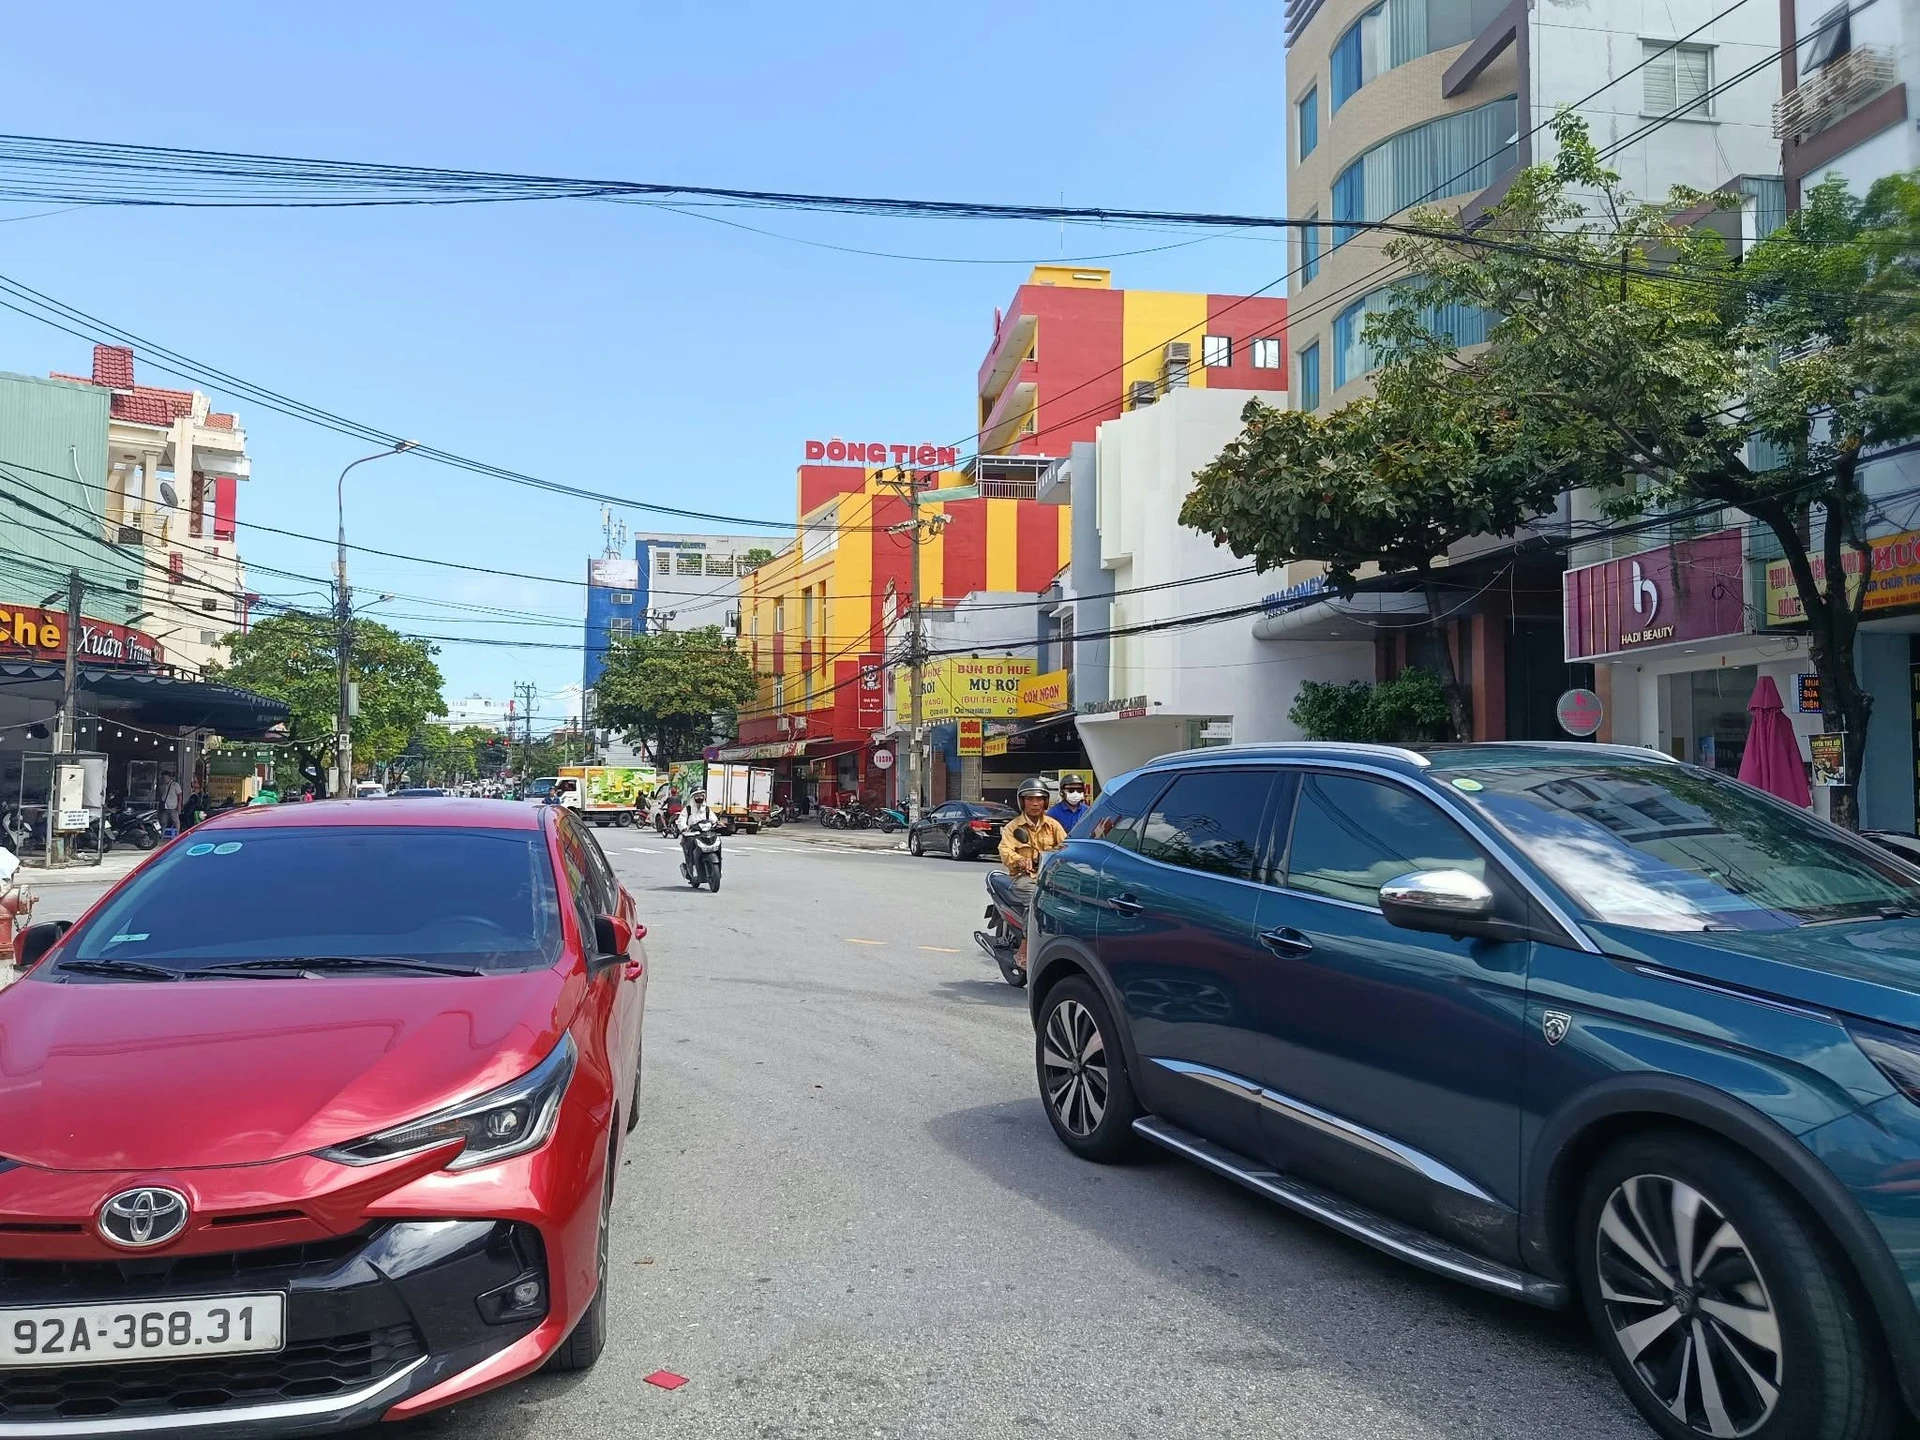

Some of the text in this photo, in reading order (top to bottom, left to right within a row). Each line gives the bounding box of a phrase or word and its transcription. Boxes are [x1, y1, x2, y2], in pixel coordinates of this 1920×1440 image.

[77, 625, 123, 659] Xuân
[1621, 625, 1675, 645] HADI BEAUTY
[969, 679, 991, 694] MỤ
[13, 1304, 255, 1355] 92A-368.31
